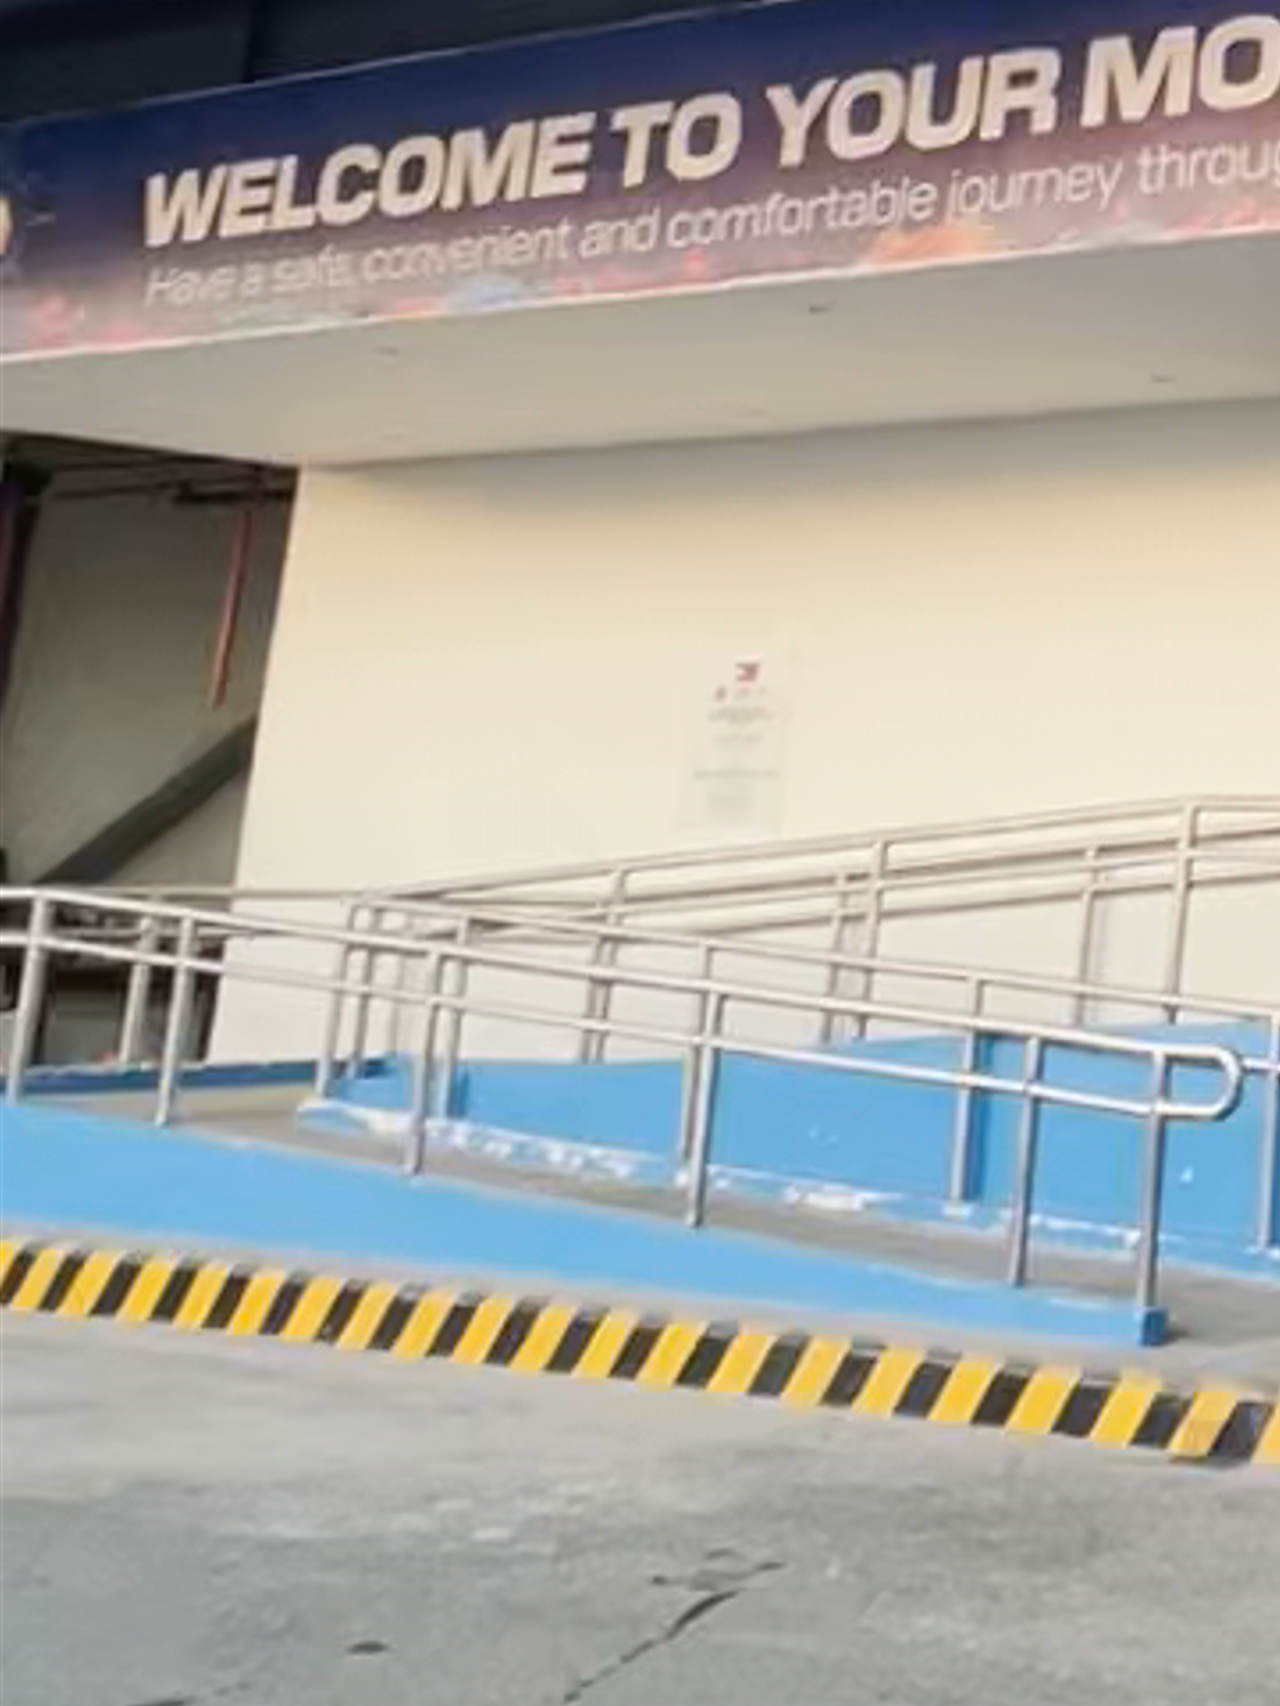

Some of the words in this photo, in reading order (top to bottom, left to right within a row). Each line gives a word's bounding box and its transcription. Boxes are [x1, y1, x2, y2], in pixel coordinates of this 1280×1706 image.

[144, 112, 596, 248] WELCOME
[610, 93, 742, 186] TO
[765, 48, 1063, 167] YOUR
[358, 220, 572, 282] convenient
[580, 200, 658, 254] and
[664, 176, 938, 248] comfortable
[949, 160, 1119, 220] journey
